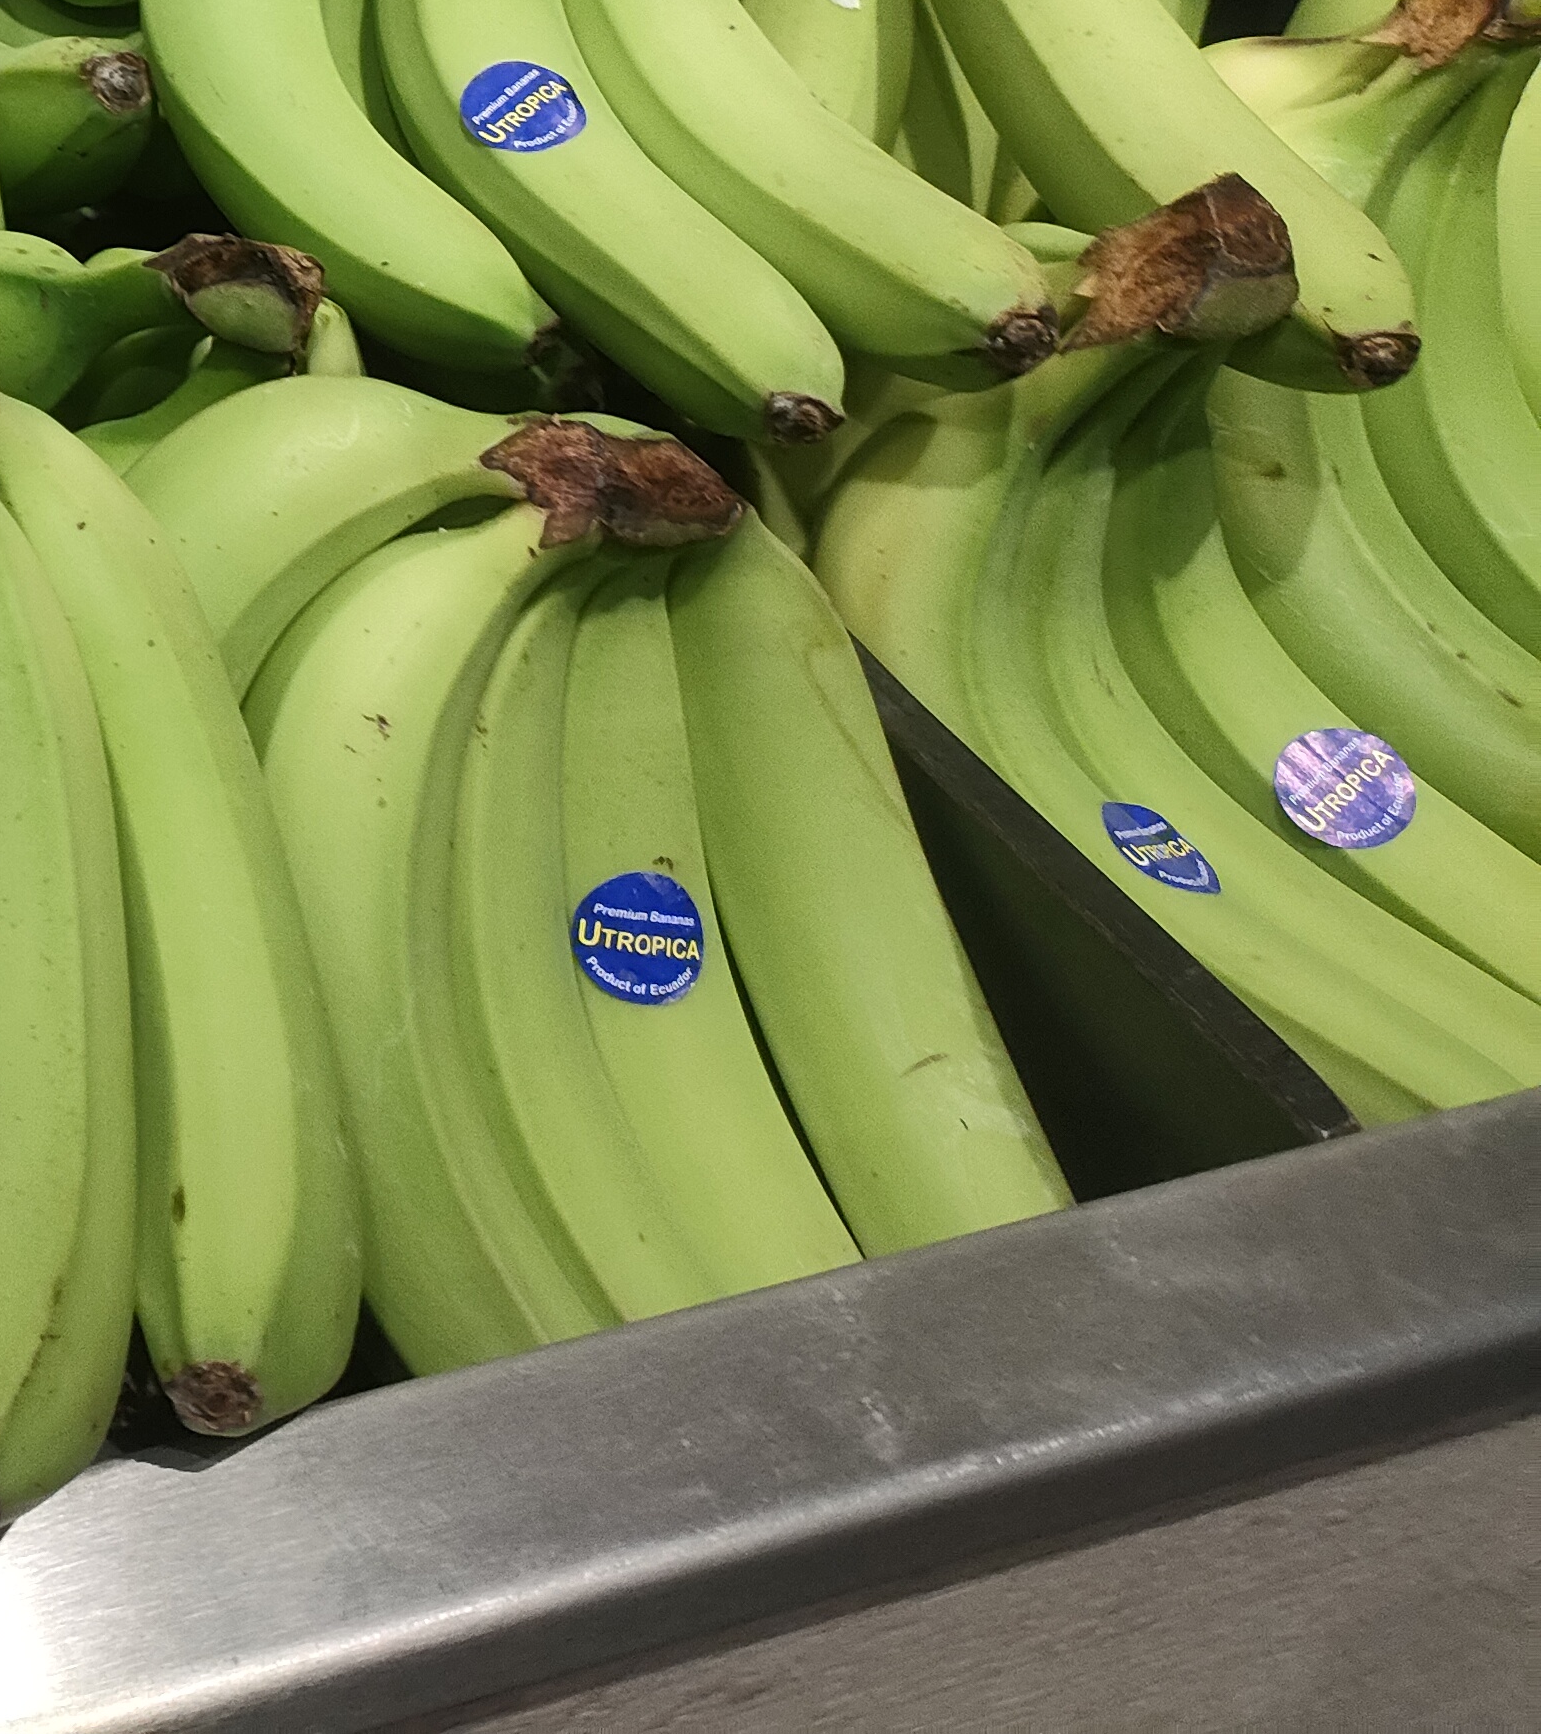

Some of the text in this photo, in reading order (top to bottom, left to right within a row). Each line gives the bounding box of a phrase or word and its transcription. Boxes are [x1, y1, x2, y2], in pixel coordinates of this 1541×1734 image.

[478, 80, 567, 143] UTROPICA
[1297, 749, 1395, 832] UTROPICA
[1336, 822, 1385, 842] Product
[593, 903, 695, 926] Premium Bananas
[578, 918, 700, 961] UTROPICA
[586, 955, 693, 996] Product Ecuador
